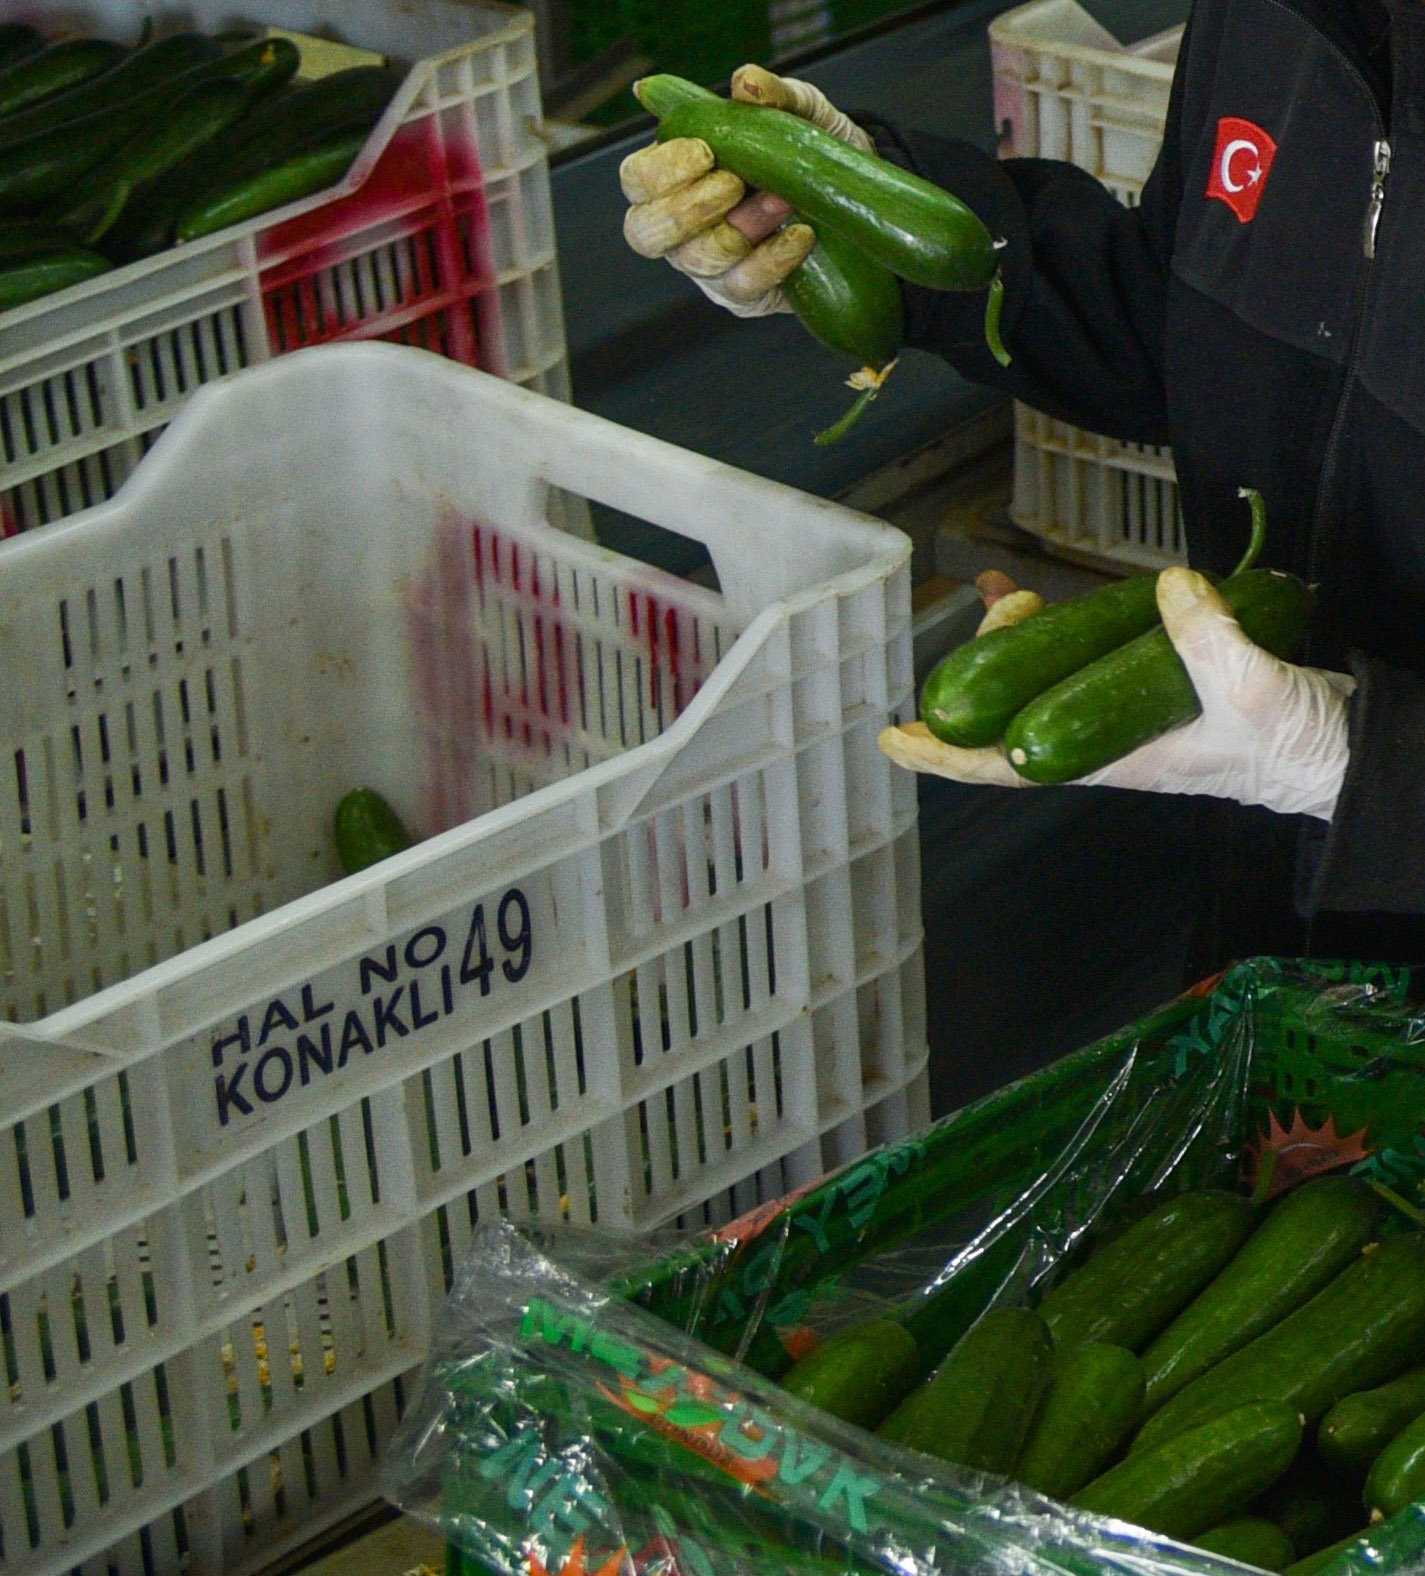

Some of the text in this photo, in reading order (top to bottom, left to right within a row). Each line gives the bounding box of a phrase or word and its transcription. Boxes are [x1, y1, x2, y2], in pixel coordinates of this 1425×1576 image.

[212, 926, 447, 1067] HAL NO
[214, 888, 532, 1126] KONAKLI 49
